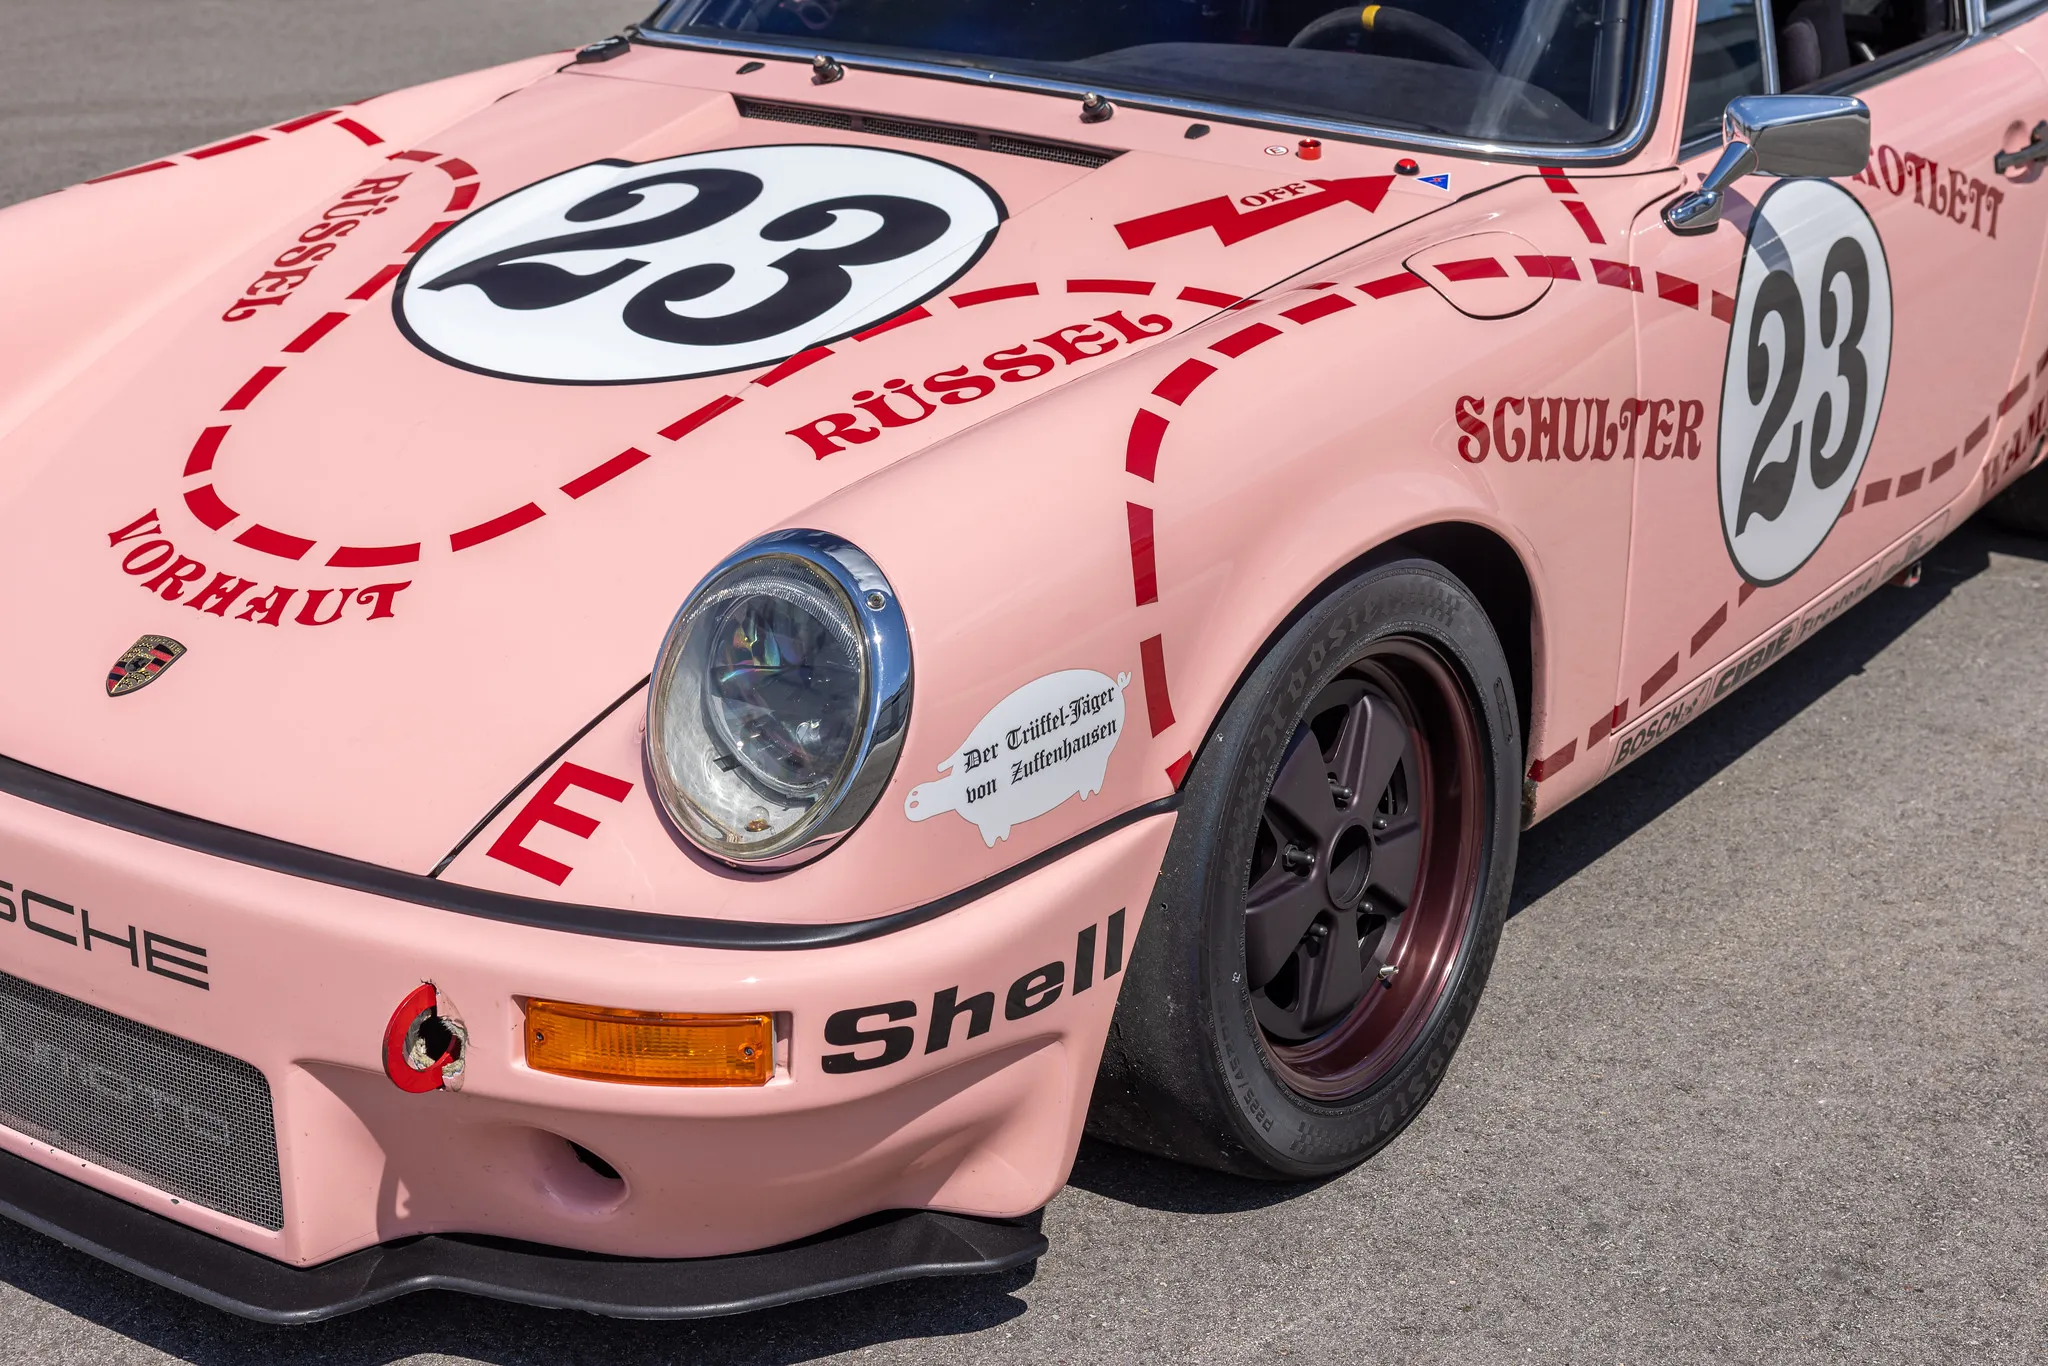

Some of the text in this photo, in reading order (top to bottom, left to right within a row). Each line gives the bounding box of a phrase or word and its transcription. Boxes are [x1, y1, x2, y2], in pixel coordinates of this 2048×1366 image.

[222, 173, 411, 322] RÜSSEL
[1239, 182, 1308, 207] OFF
[419, 168, 951, 346] 23
[785, 310, 1173, 461] RÜSSEL
[1455, 394, 1705, 464] SCHULTER
[1735, 237, 1871, 538] 23
[107, 508, 413, 628] VORHAUT
[963, 687, 1115, 773] Der Trüffel-Jäger
[966, 719, 1117, 804] von Zuffenhausen
[1613, 702, 1681, 767] BOSCH
[485, 760, 635, 887] E
[822, 907, 1126, 1075] Shell
